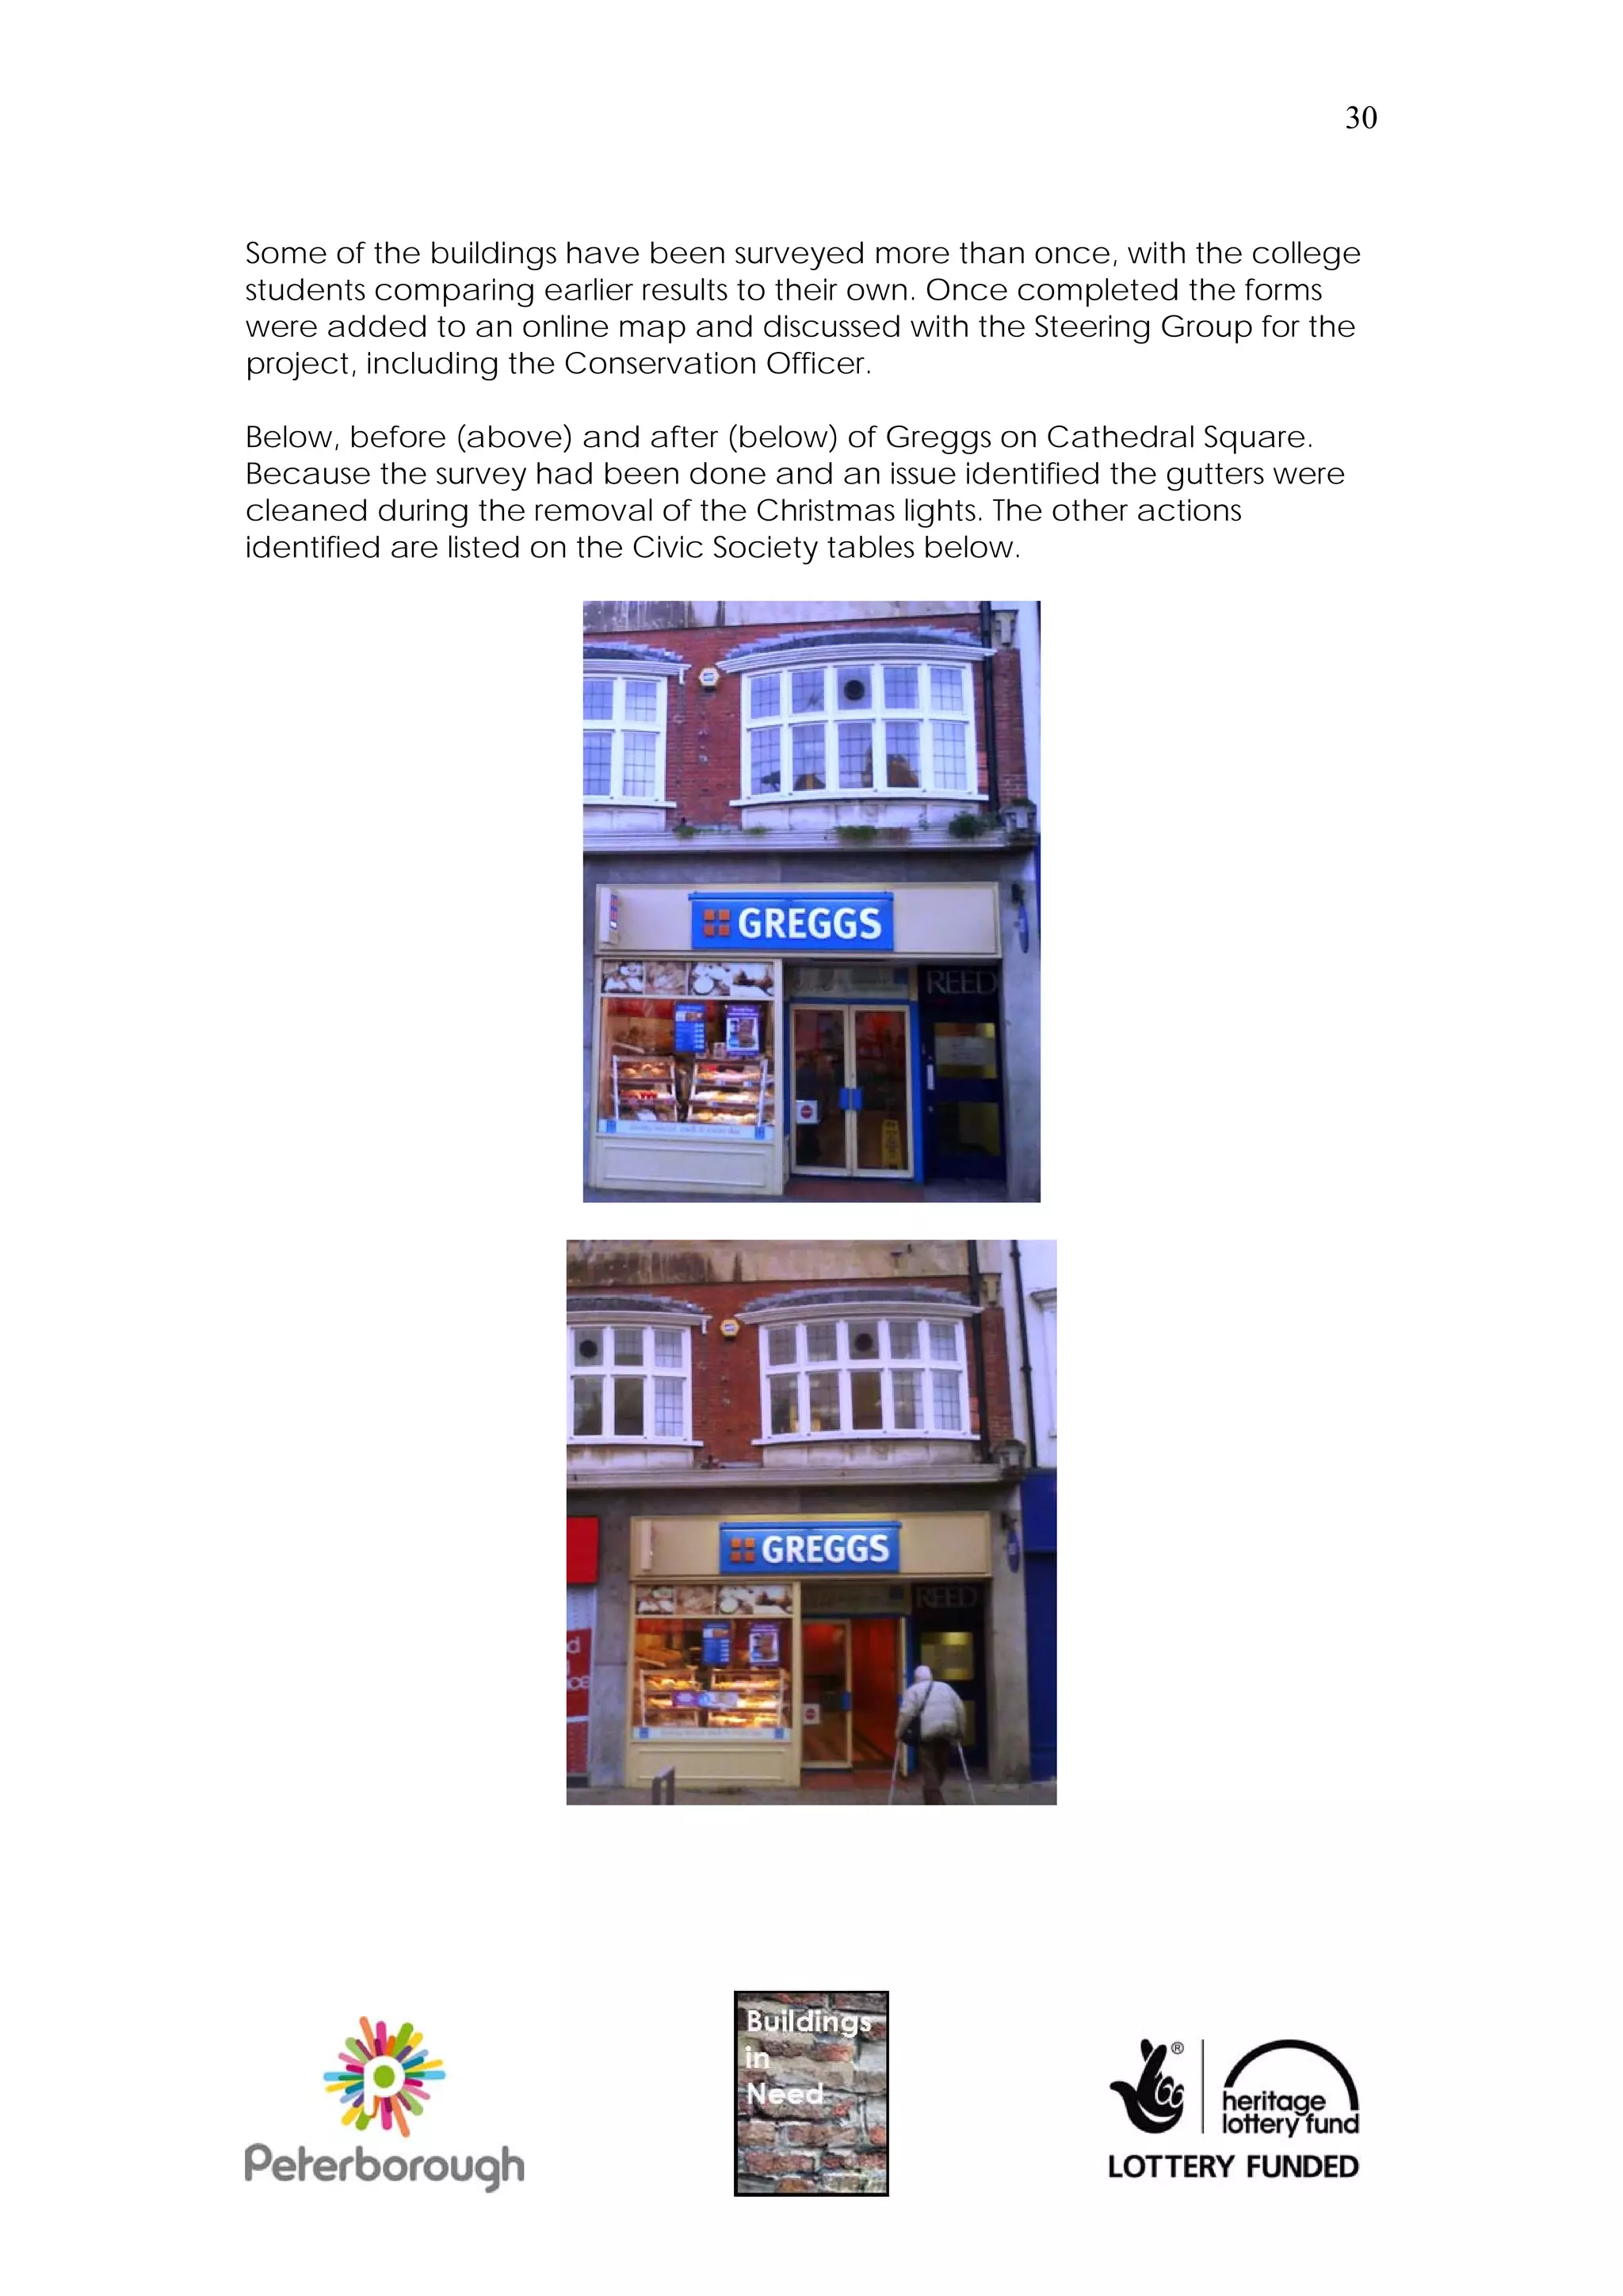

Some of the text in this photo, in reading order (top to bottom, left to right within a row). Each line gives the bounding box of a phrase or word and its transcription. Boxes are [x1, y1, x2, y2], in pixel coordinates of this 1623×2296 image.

[1346, 105, 1377, 129] 30
[246, 241, 1361, 271] Some of the buildings have been surveyed more than once, with the college
[246, 277, 1323, 308] students comparing earlier results to their own. Once completed the forms
[245, 314, 1356, 345] were added to an online map and discussed with the Steering Group for the
[247, 351, 871, 381] project, including the Conservation Officer.
[247, 423, 1312, 455] Below, before (above) and after (below) of Greggs on Cathedral Square.
[247, 461, 1345, 491] Because the survey had been done and an issue identified the gutters were
[246, 498, 1242, 529] cleaned during the removal of the Christmas lights. The other actions
[246, 535, 1020, 565] identified are listed on the Civic Society tables below.
[738, 907, 883, 940] GREGGS
[926, 969, 998, 995] REED
[762, 1534, 890, 1564] GREGGS
[916, 1586, 979, 1609] REED
[747, 2008, 872, 2038] Buildings
[745, 2045, 771, 2069] in
[747, 2082, 823, 2105] Need
[1222, 2090, 1327, 2116] heritage
[1222, 2113, 1360, 2138] lottery fund
[244, 2142, 525, 2194] Peterborough
[1108, 2154, 1360, 2178] LOTTERY FUNDED
